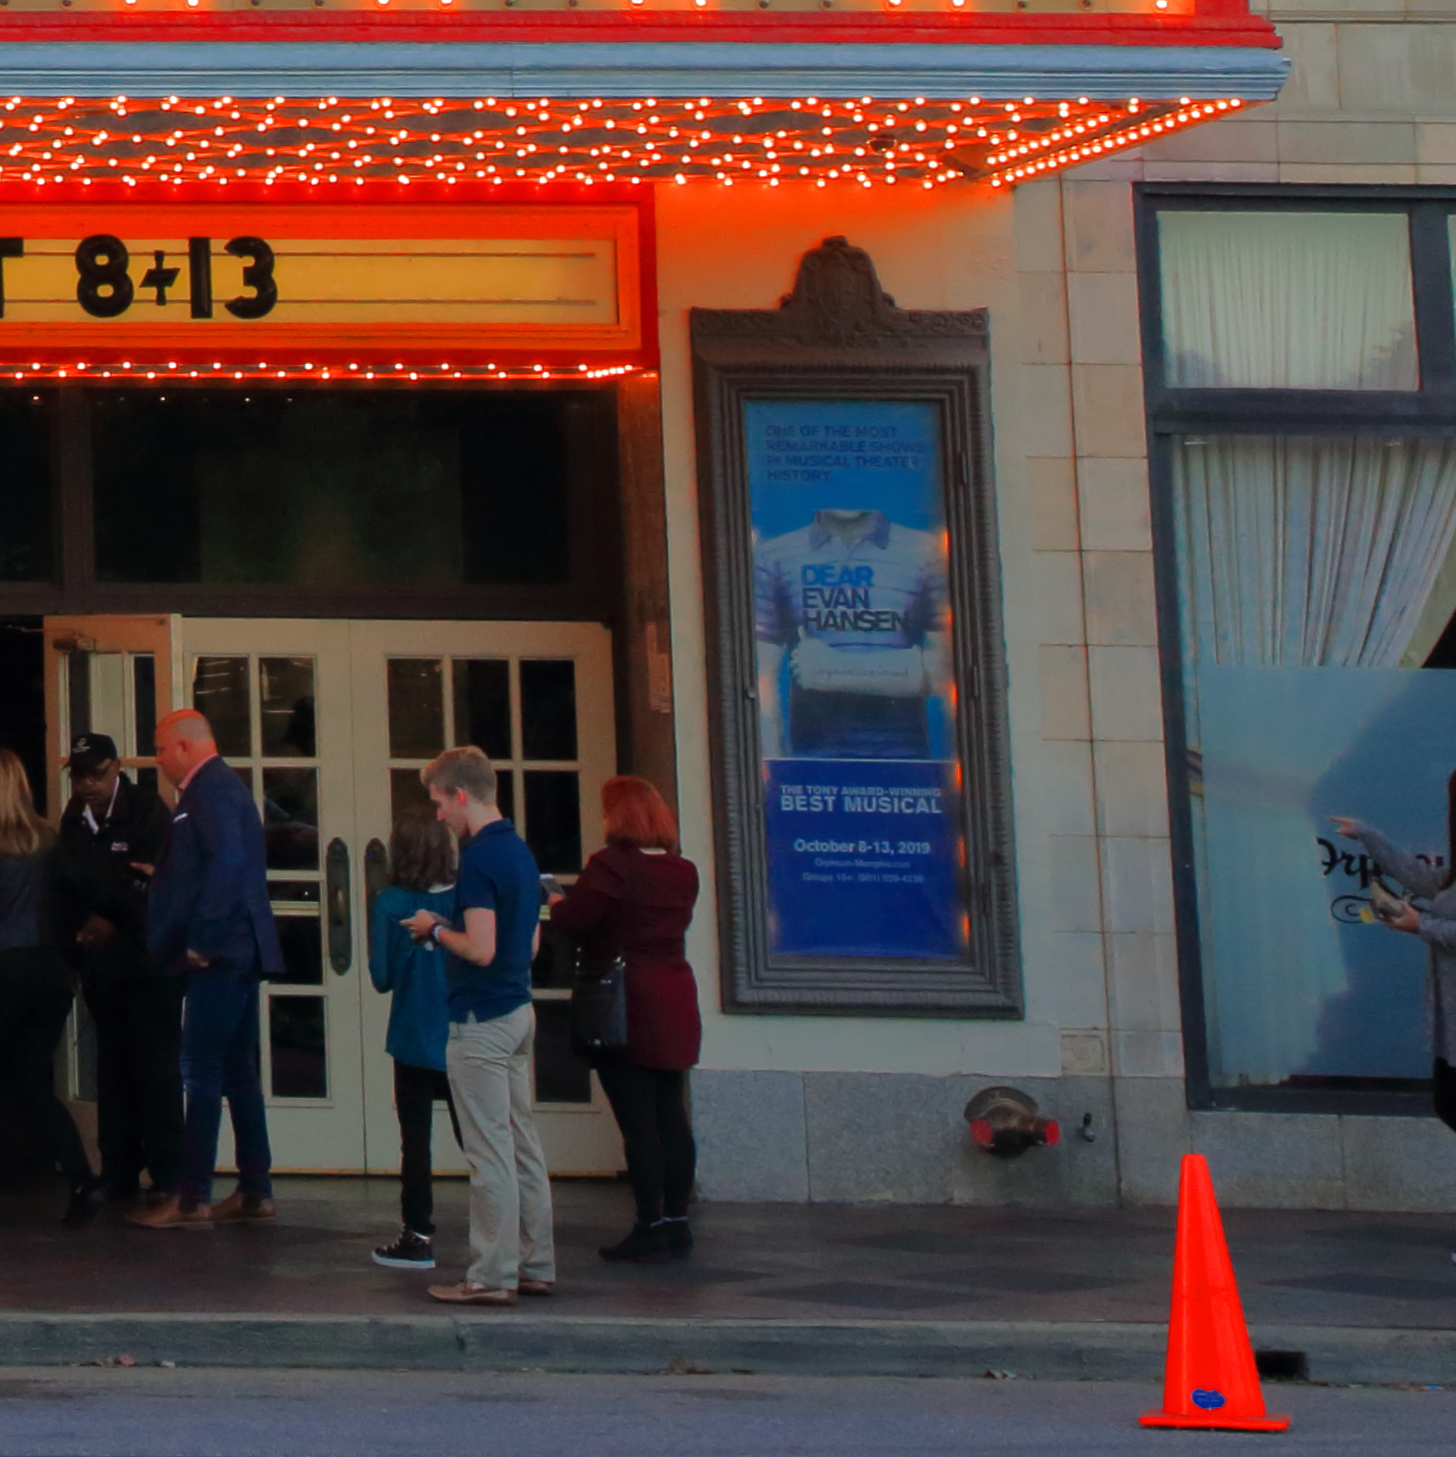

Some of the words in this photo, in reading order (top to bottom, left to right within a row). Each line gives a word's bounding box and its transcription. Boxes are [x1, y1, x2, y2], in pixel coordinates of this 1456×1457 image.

[766, 440, 866, 453] REMARKABLE
[802, 565, 874, 586] DEAR
[802, 587, 869, 608] EVAN
[803, 610, 907, 631] HANSEN
[781, 785, 803, 794] THE
[806, 785, 837, 794] TONY
[841, 786, 941, 797] AWARD-WINNING
[781, 795, 836, 812] BEST
[844, 797, 942, 814] MUSICAL
[794, 839, 854, 853] October
[858, 841, 895, 855] 8-13,
[898, 841, 930, 854] 2019
